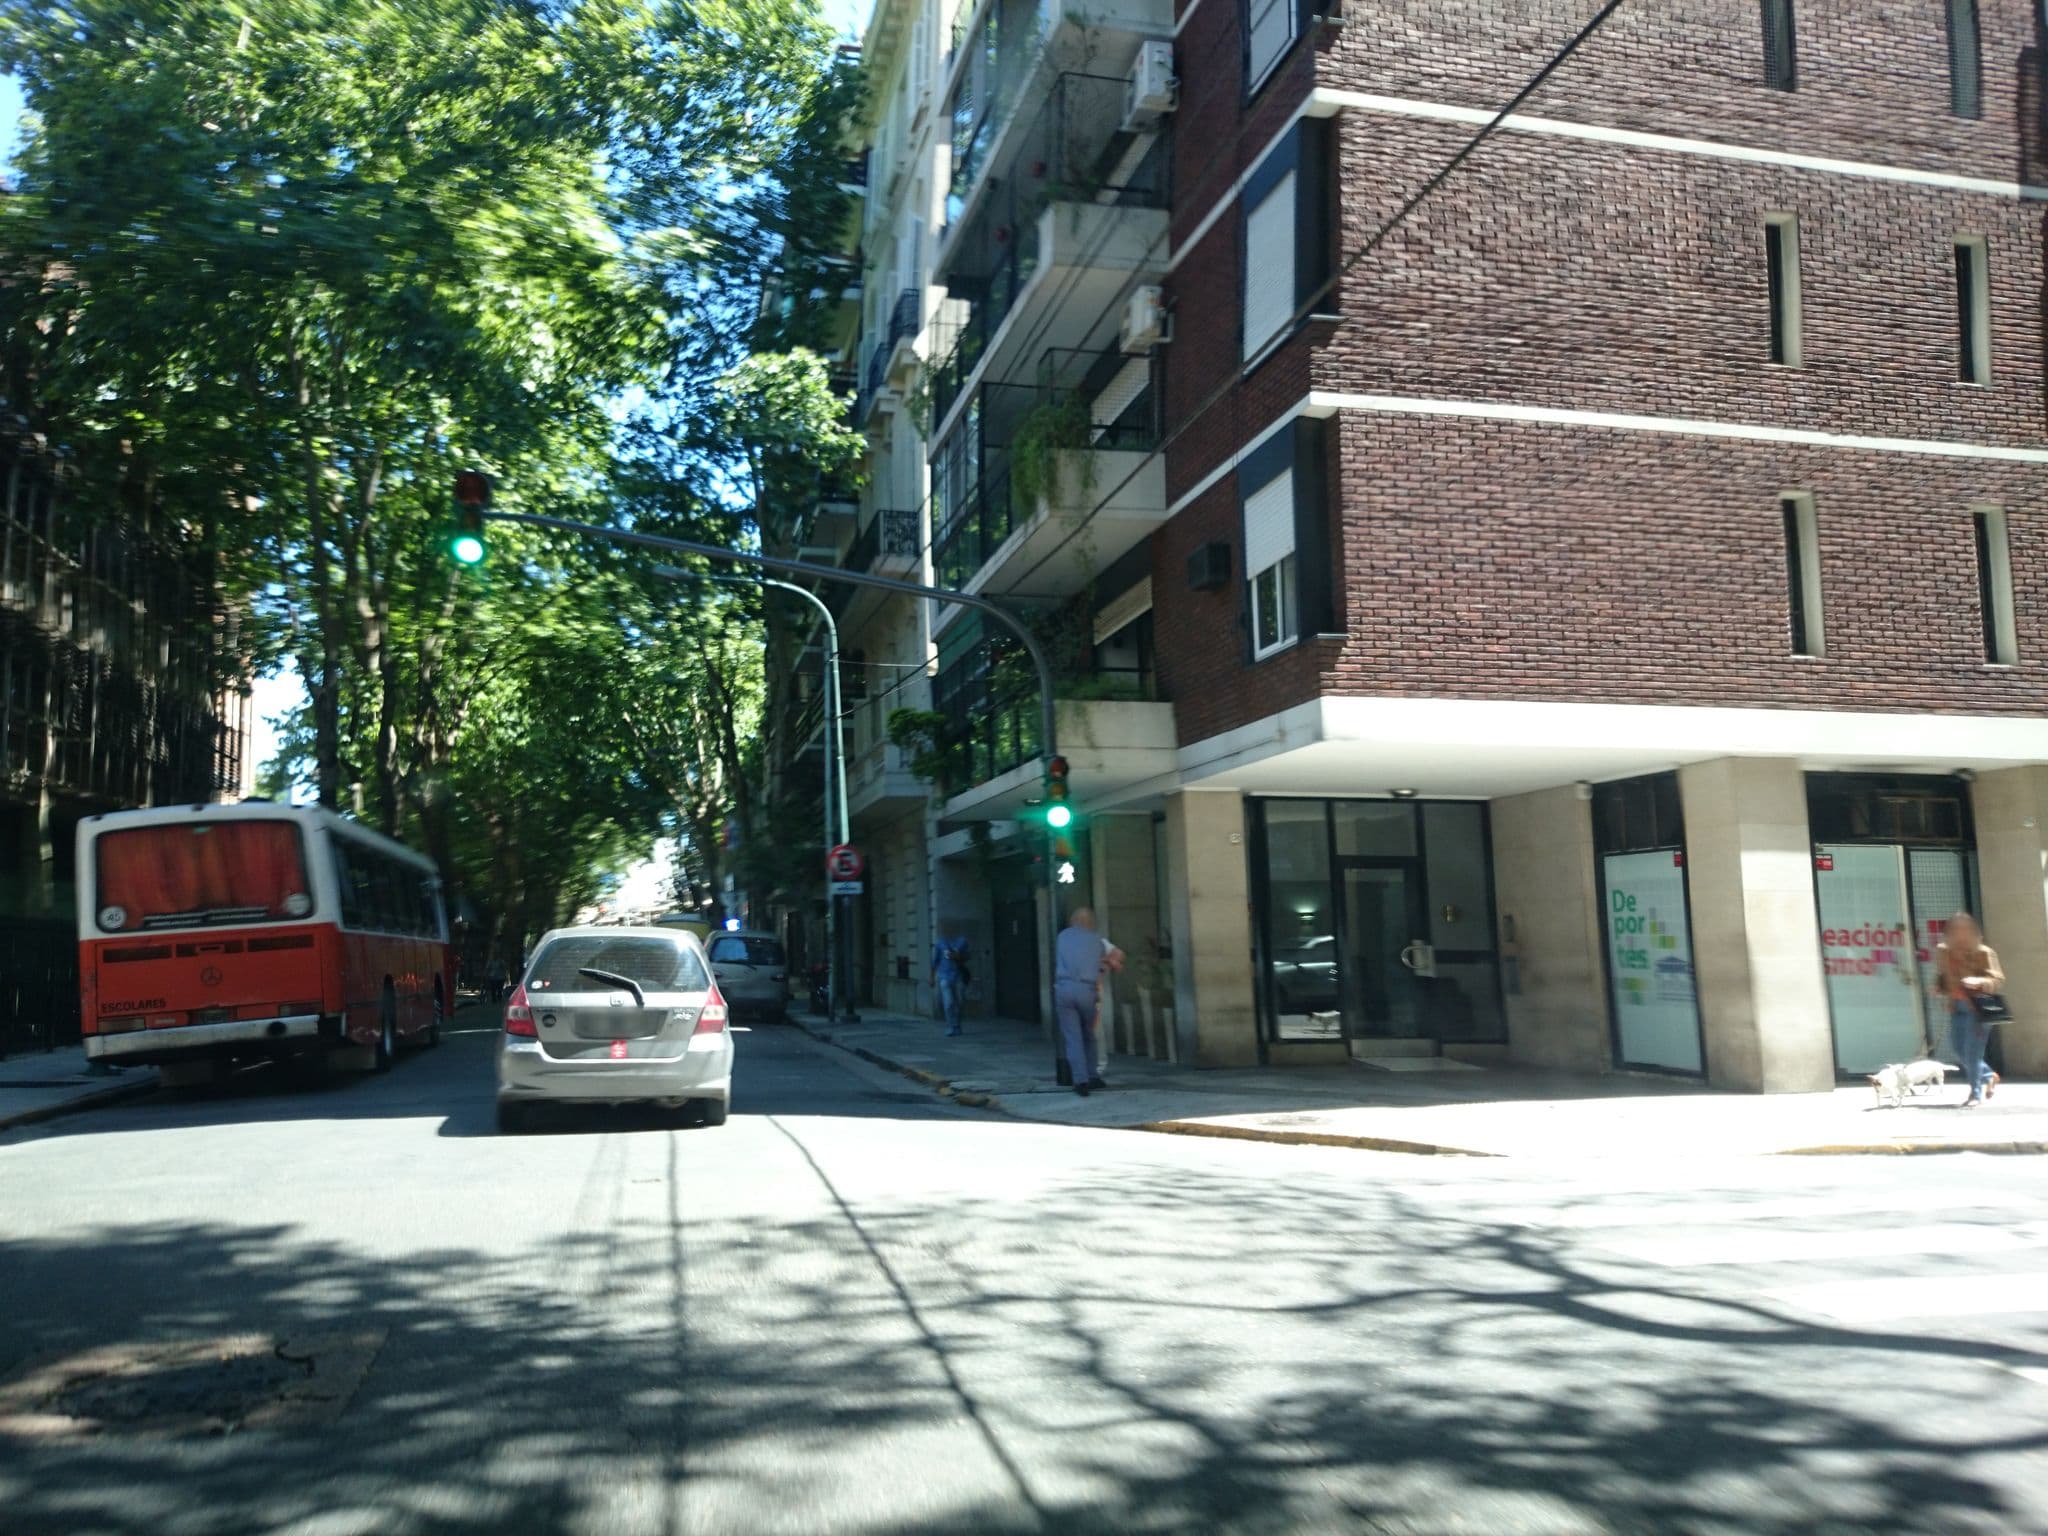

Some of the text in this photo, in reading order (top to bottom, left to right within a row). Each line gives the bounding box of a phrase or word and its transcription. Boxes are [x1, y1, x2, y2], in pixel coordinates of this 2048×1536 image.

[1612, 889, 1636, 912] De
[1614, 916, 1645, 939] por
[1616, 945, 1650, 969] tes
[102, 998, 166, 1014] ESCOLARES
